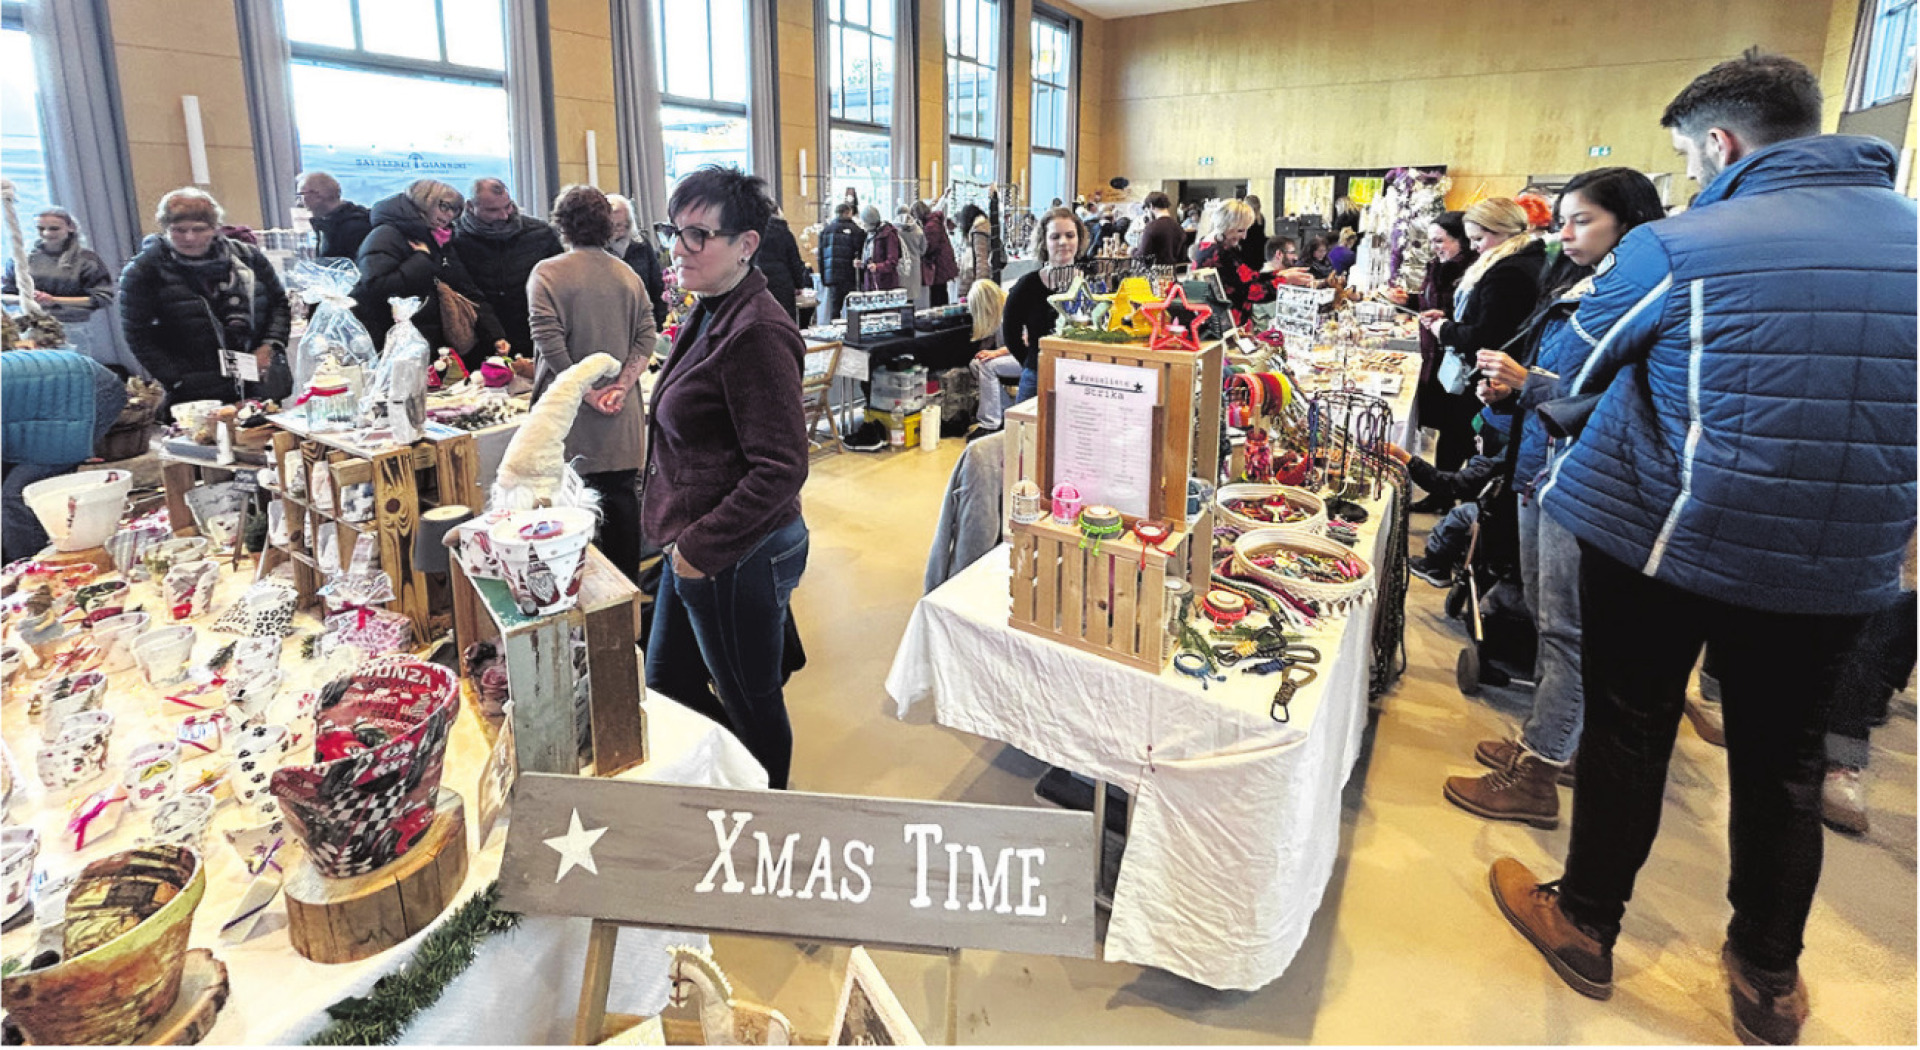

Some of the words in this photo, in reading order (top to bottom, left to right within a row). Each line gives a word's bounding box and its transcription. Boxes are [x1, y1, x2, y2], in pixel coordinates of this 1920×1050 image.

[1084, 387, 1125, 400] Strika
[695, 810, 874, 903] XMAS
[904, 823, 1046, 916] TIME
